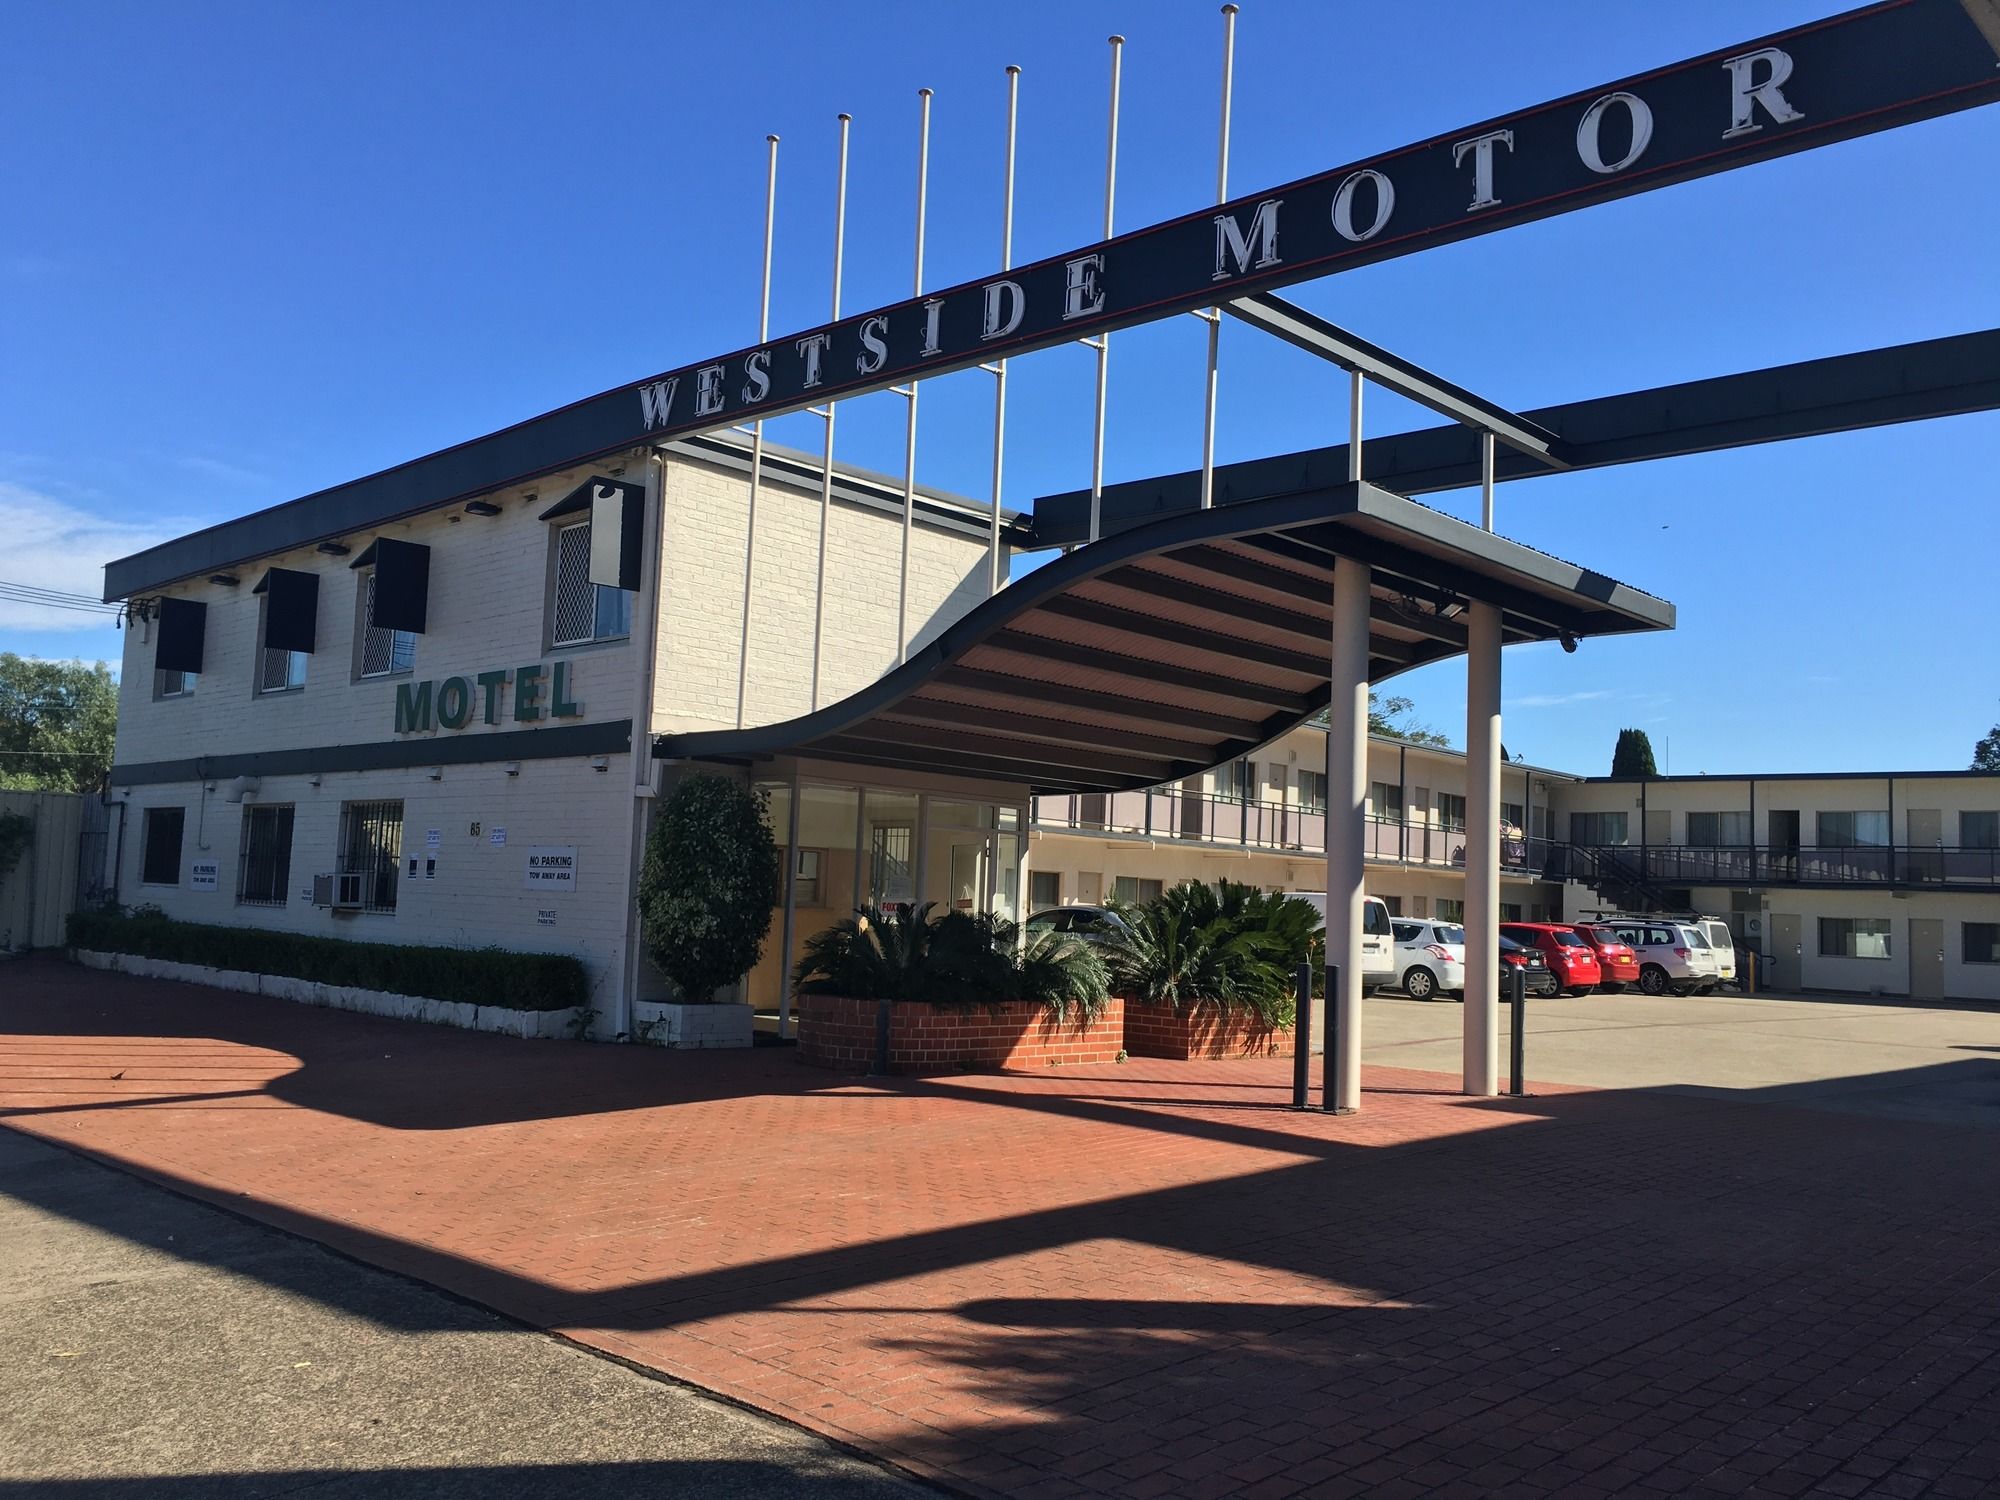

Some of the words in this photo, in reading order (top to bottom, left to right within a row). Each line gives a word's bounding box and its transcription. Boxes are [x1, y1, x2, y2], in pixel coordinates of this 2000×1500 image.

[638, 253, 1106, 431] WESTSIDE
[1212, 47, 1805, 281] MOTOR
[395, 661, 584, 733] MOTEL
[529, 856, 539, 866] NO
[541, 856, 572, 866] PARKING
